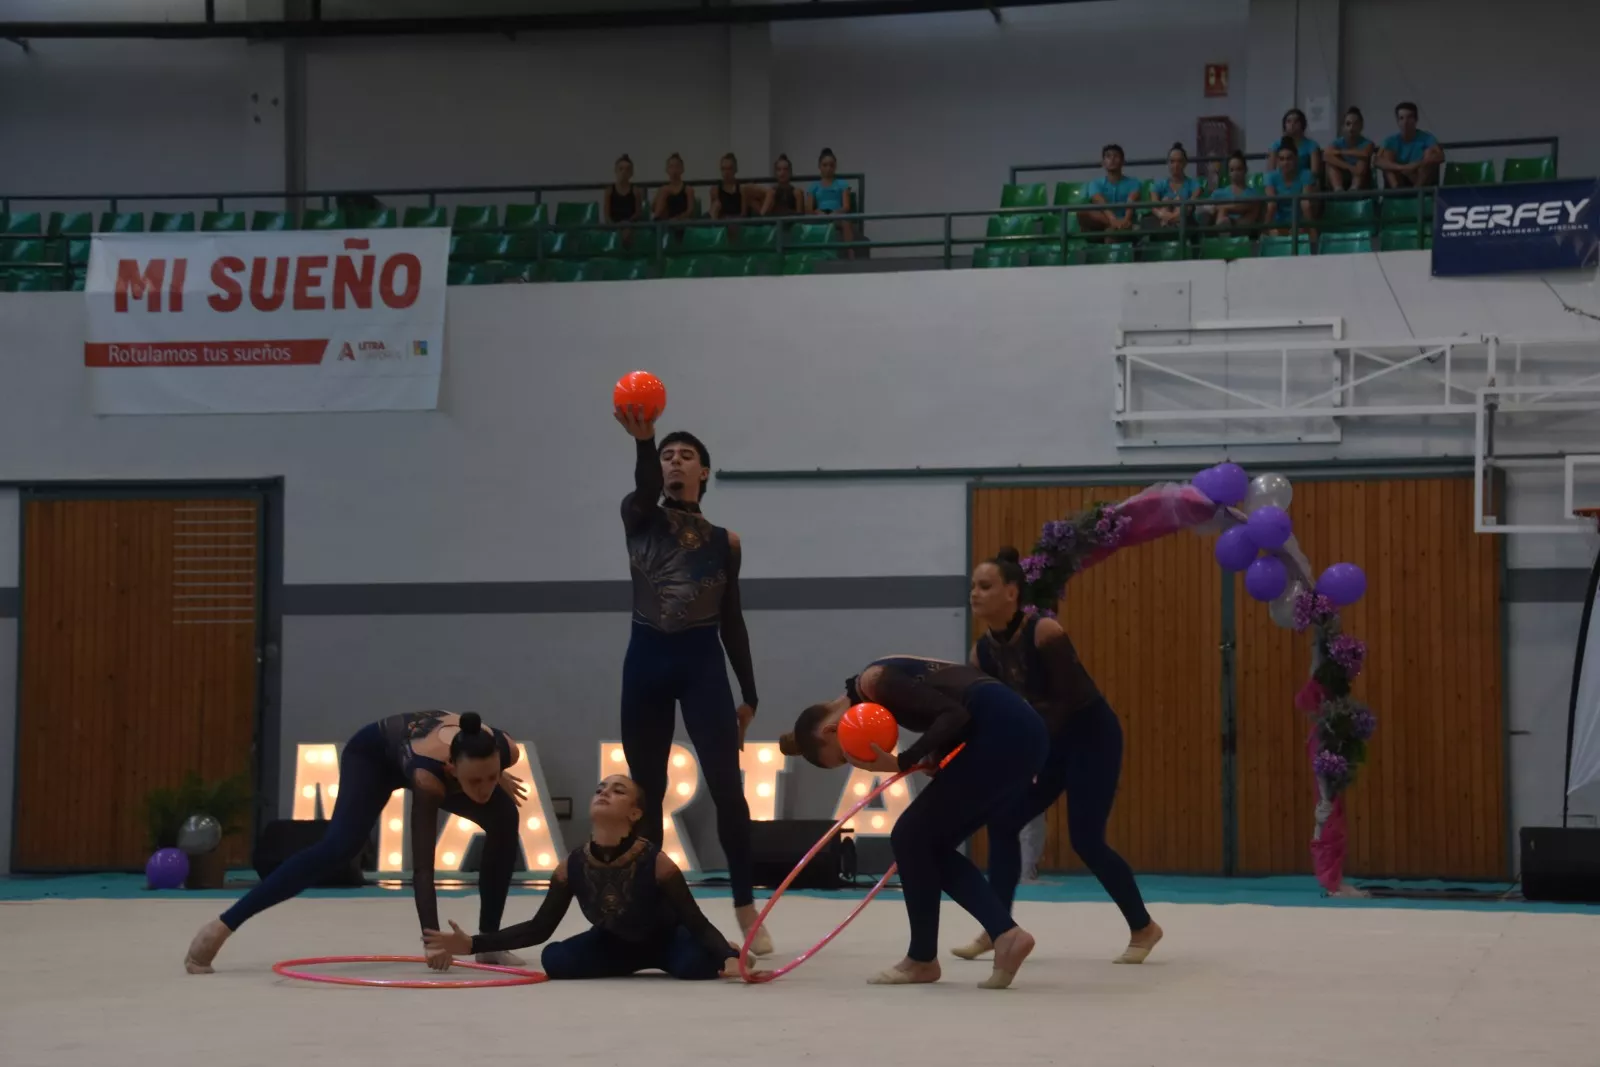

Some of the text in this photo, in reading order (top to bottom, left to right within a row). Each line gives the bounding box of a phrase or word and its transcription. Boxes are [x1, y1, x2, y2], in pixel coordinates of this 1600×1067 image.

[1442, 198, 1590, 231] SERFEY
[114, 238, 422, 313] MI SUEÑO
[108, 343, 291, 363] Rotulamos tus sueños
